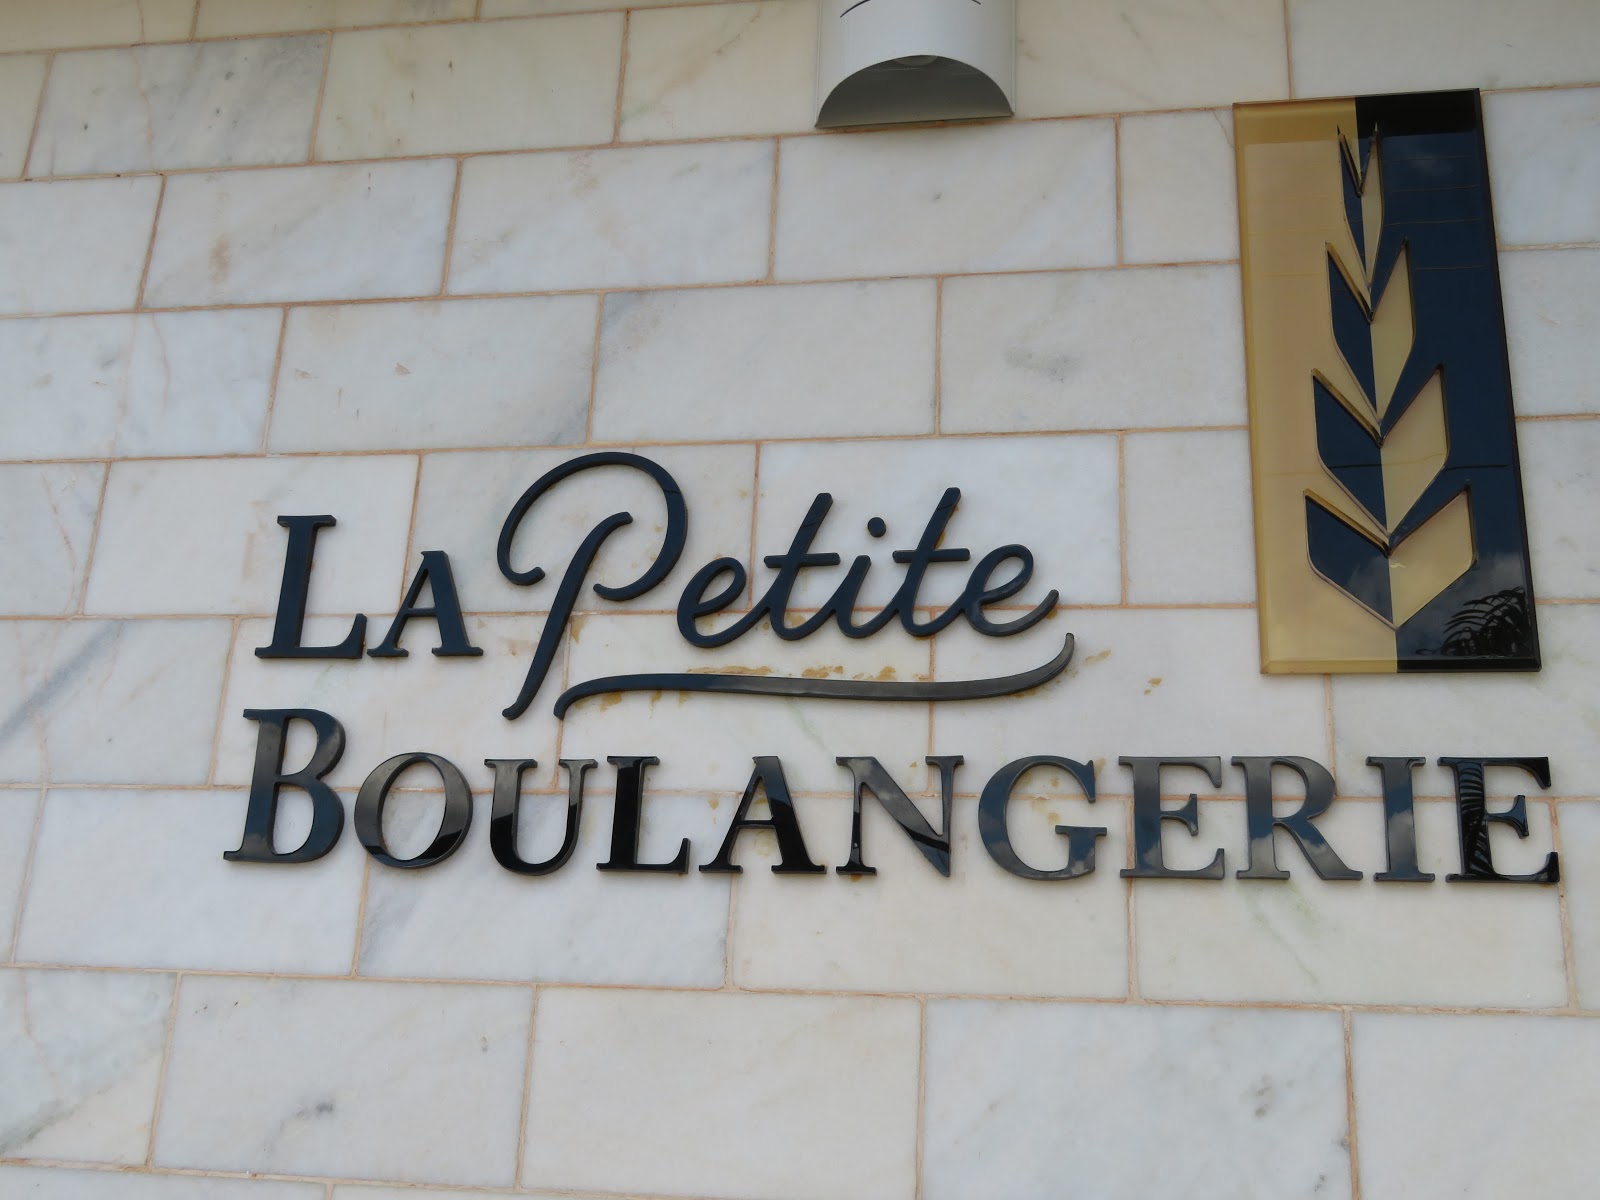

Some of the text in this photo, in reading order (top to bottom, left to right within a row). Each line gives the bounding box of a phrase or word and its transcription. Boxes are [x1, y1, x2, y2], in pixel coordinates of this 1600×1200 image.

[255, 452, 1061, 721] LA Petite
[223, 708, 1562, 888] BOULANGERIE
